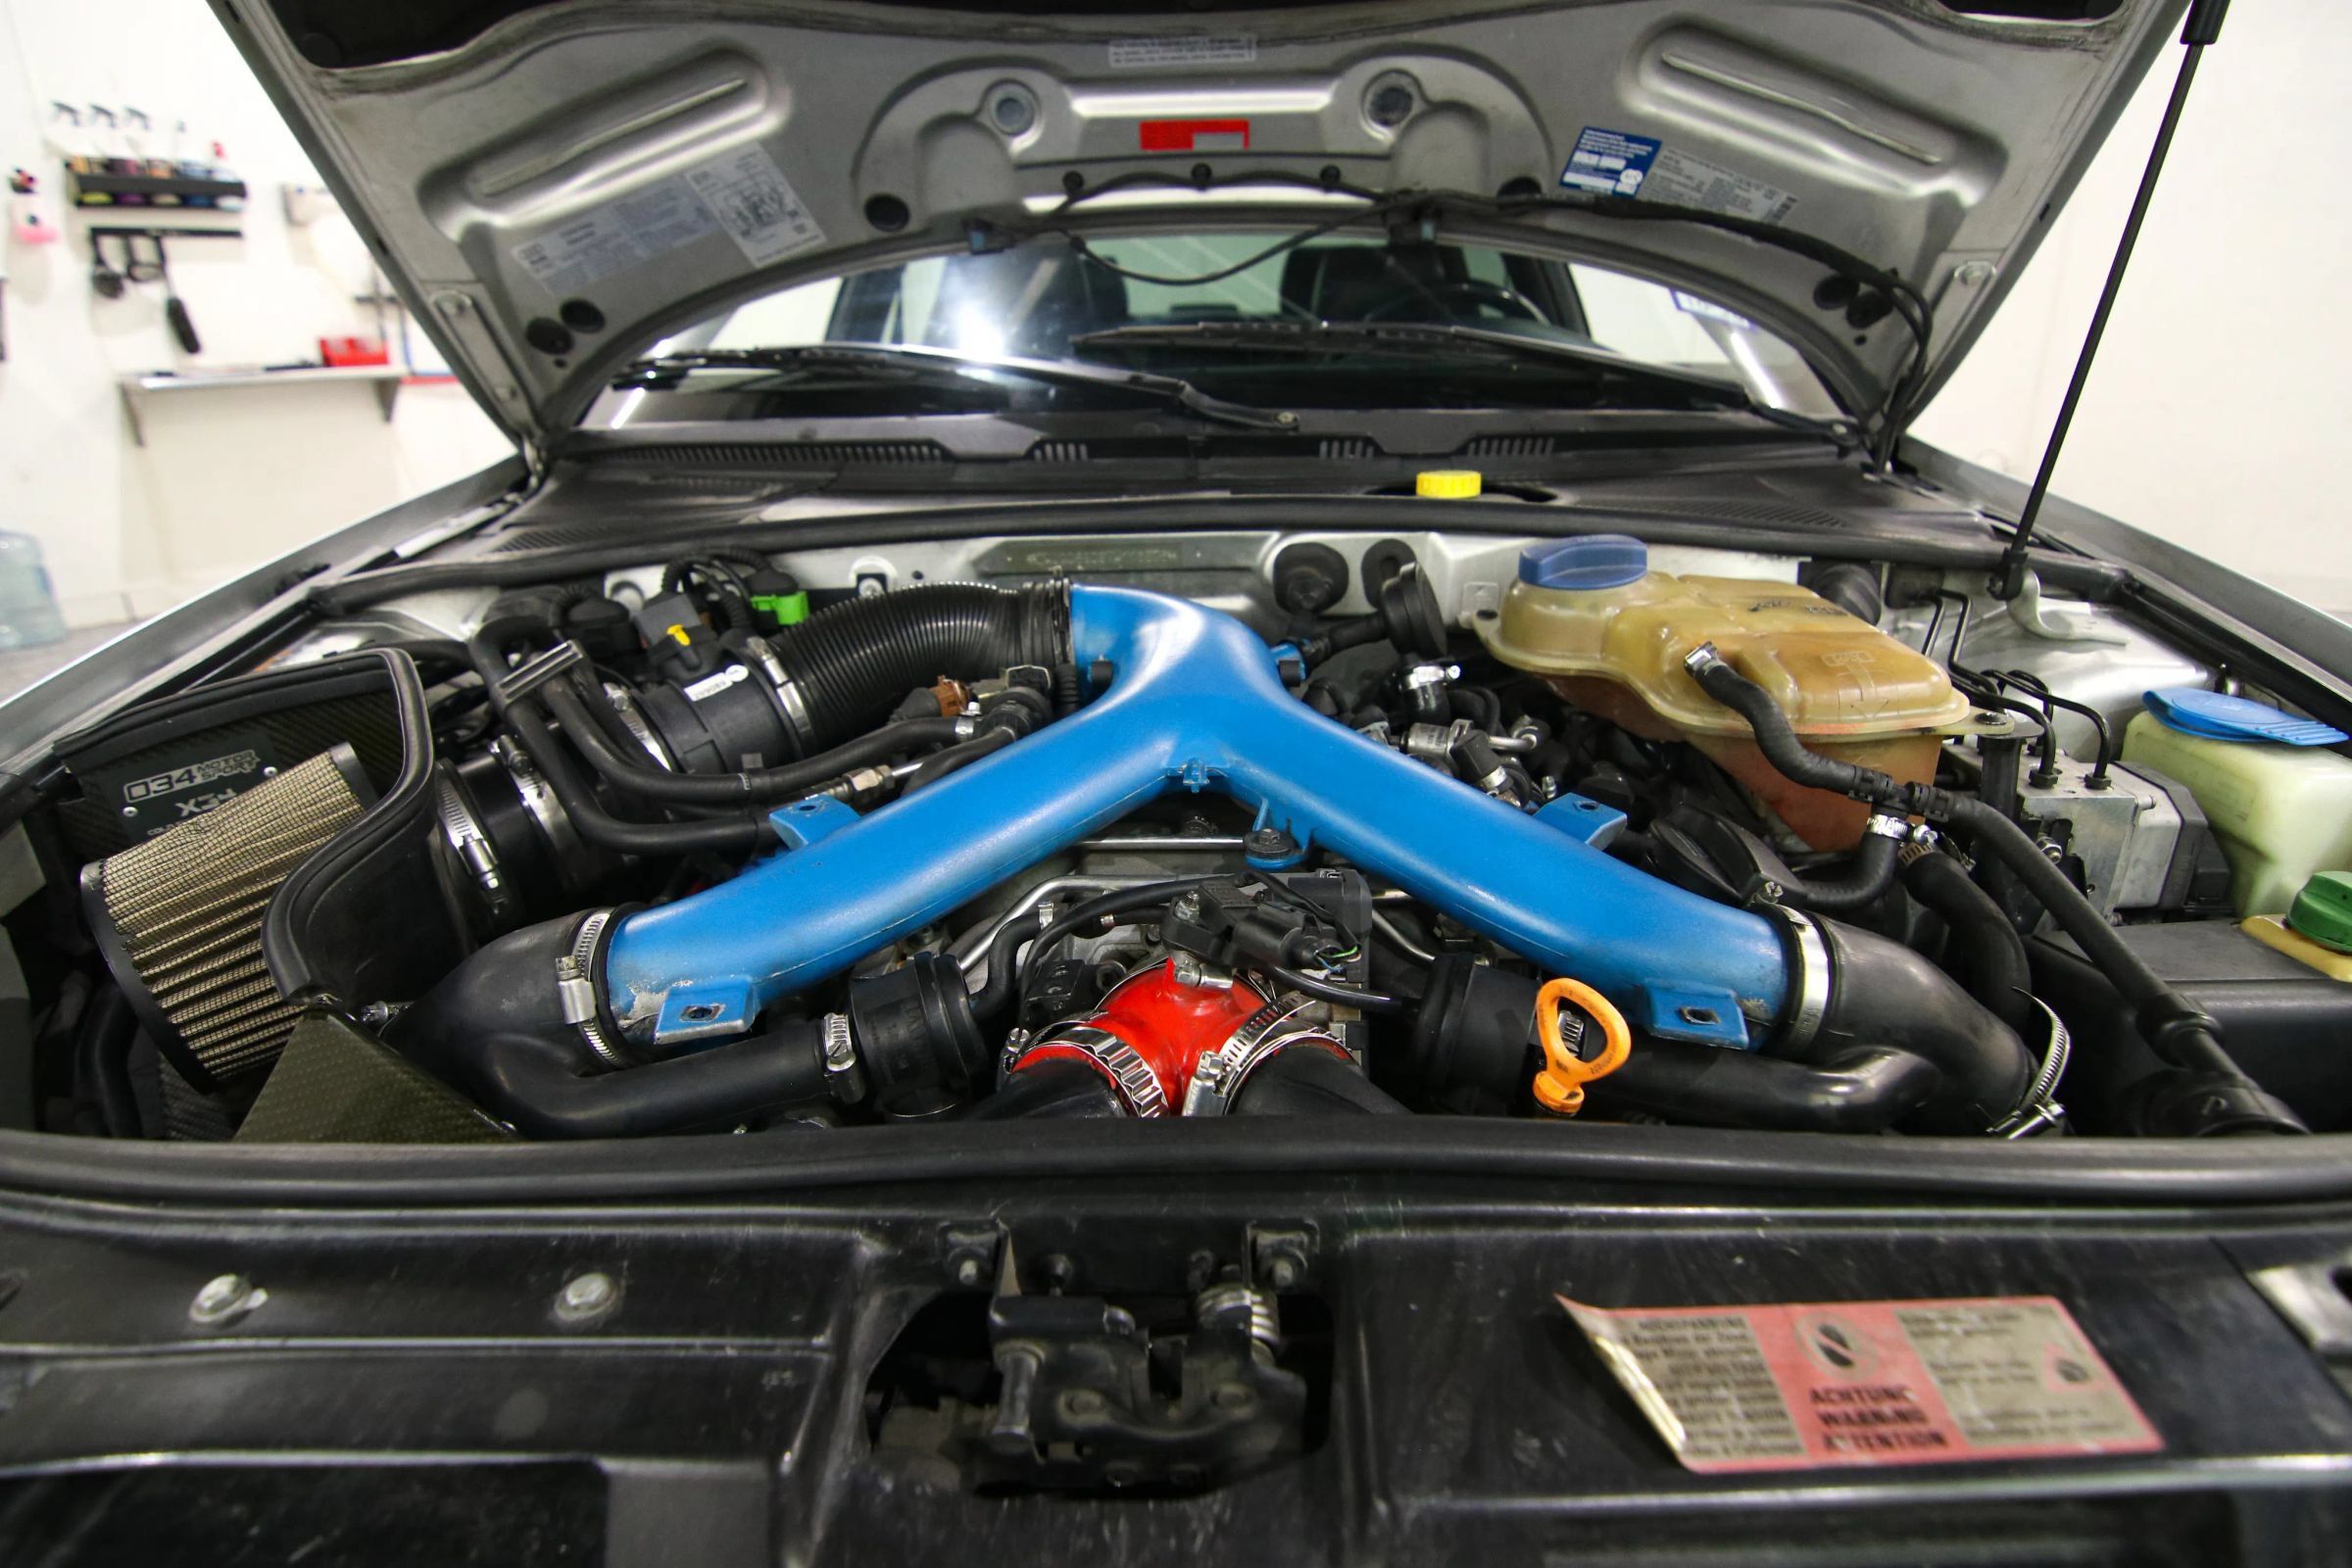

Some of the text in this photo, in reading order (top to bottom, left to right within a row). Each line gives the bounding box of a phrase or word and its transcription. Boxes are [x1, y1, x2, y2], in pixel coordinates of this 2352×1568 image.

[197, 752, 254, 773] MOTOR
[201, 759, 257, 779] SPORT
[127, 768, 197, 800] 034
[1816, 1406, 1928, 1427] WARNING
